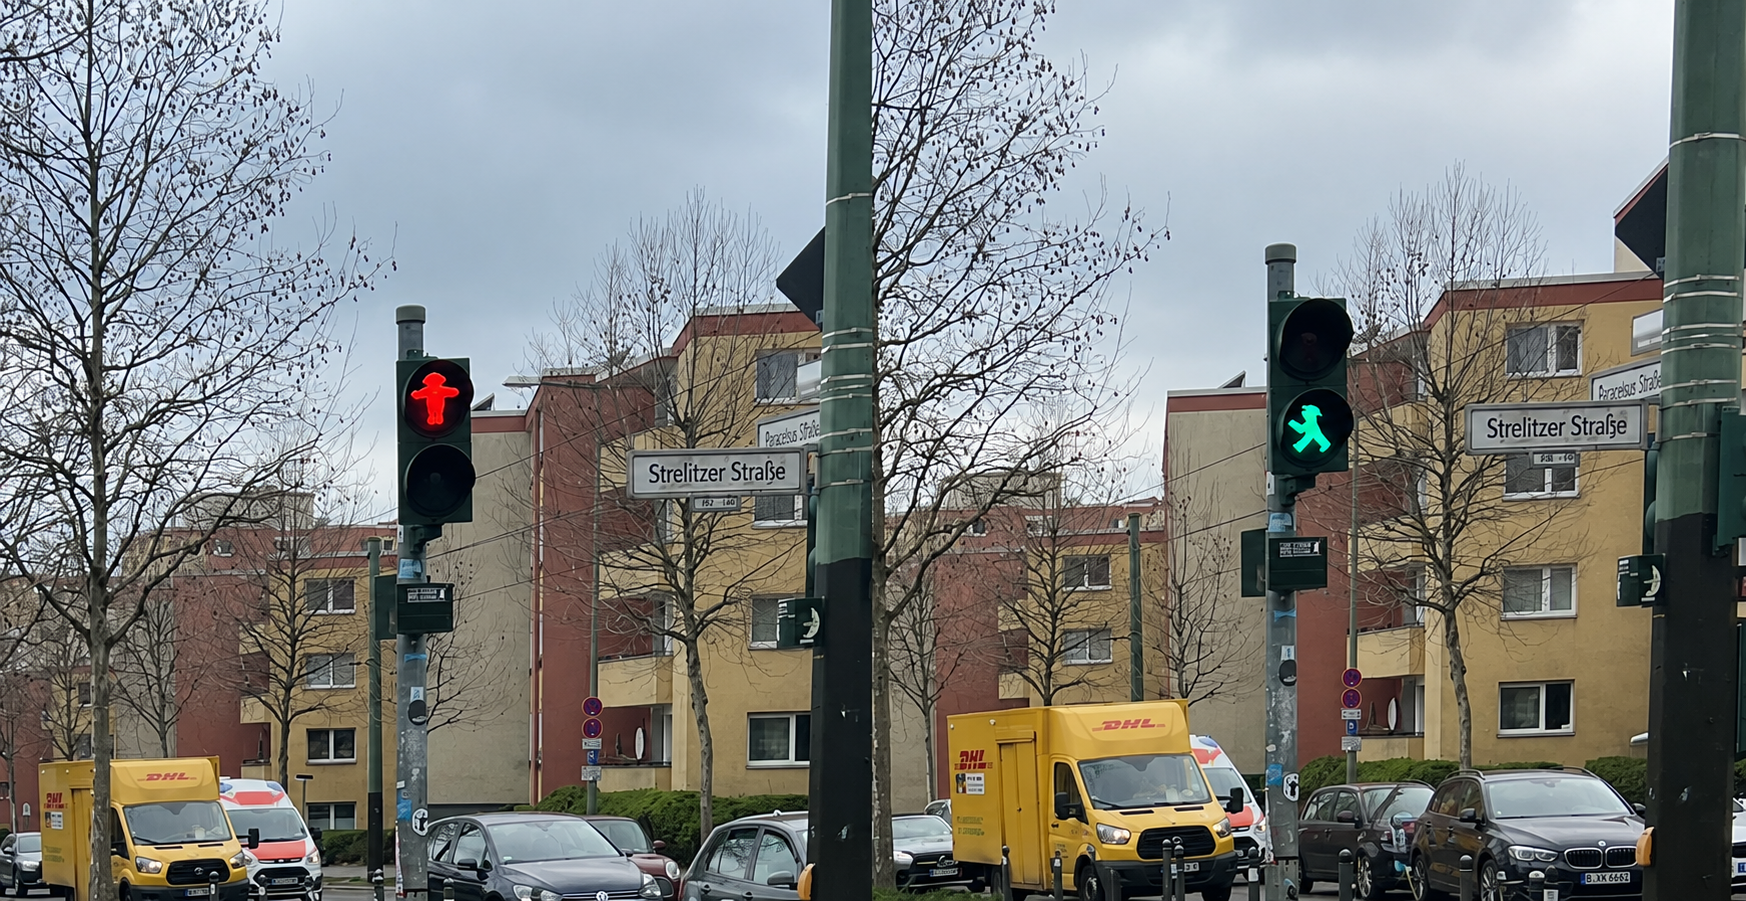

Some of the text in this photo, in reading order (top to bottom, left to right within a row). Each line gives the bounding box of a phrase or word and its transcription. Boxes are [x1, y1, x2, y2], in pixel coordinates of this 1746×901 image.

[1487, 413, 1627, 439] Strelitzer Straße
[649, 460, 786, 484] Strelitzer Straße
[1101, 718, 1156, 731] DHL
[959, 749, 987, 770] DHL
[146, 772, 190, 781] DHL
